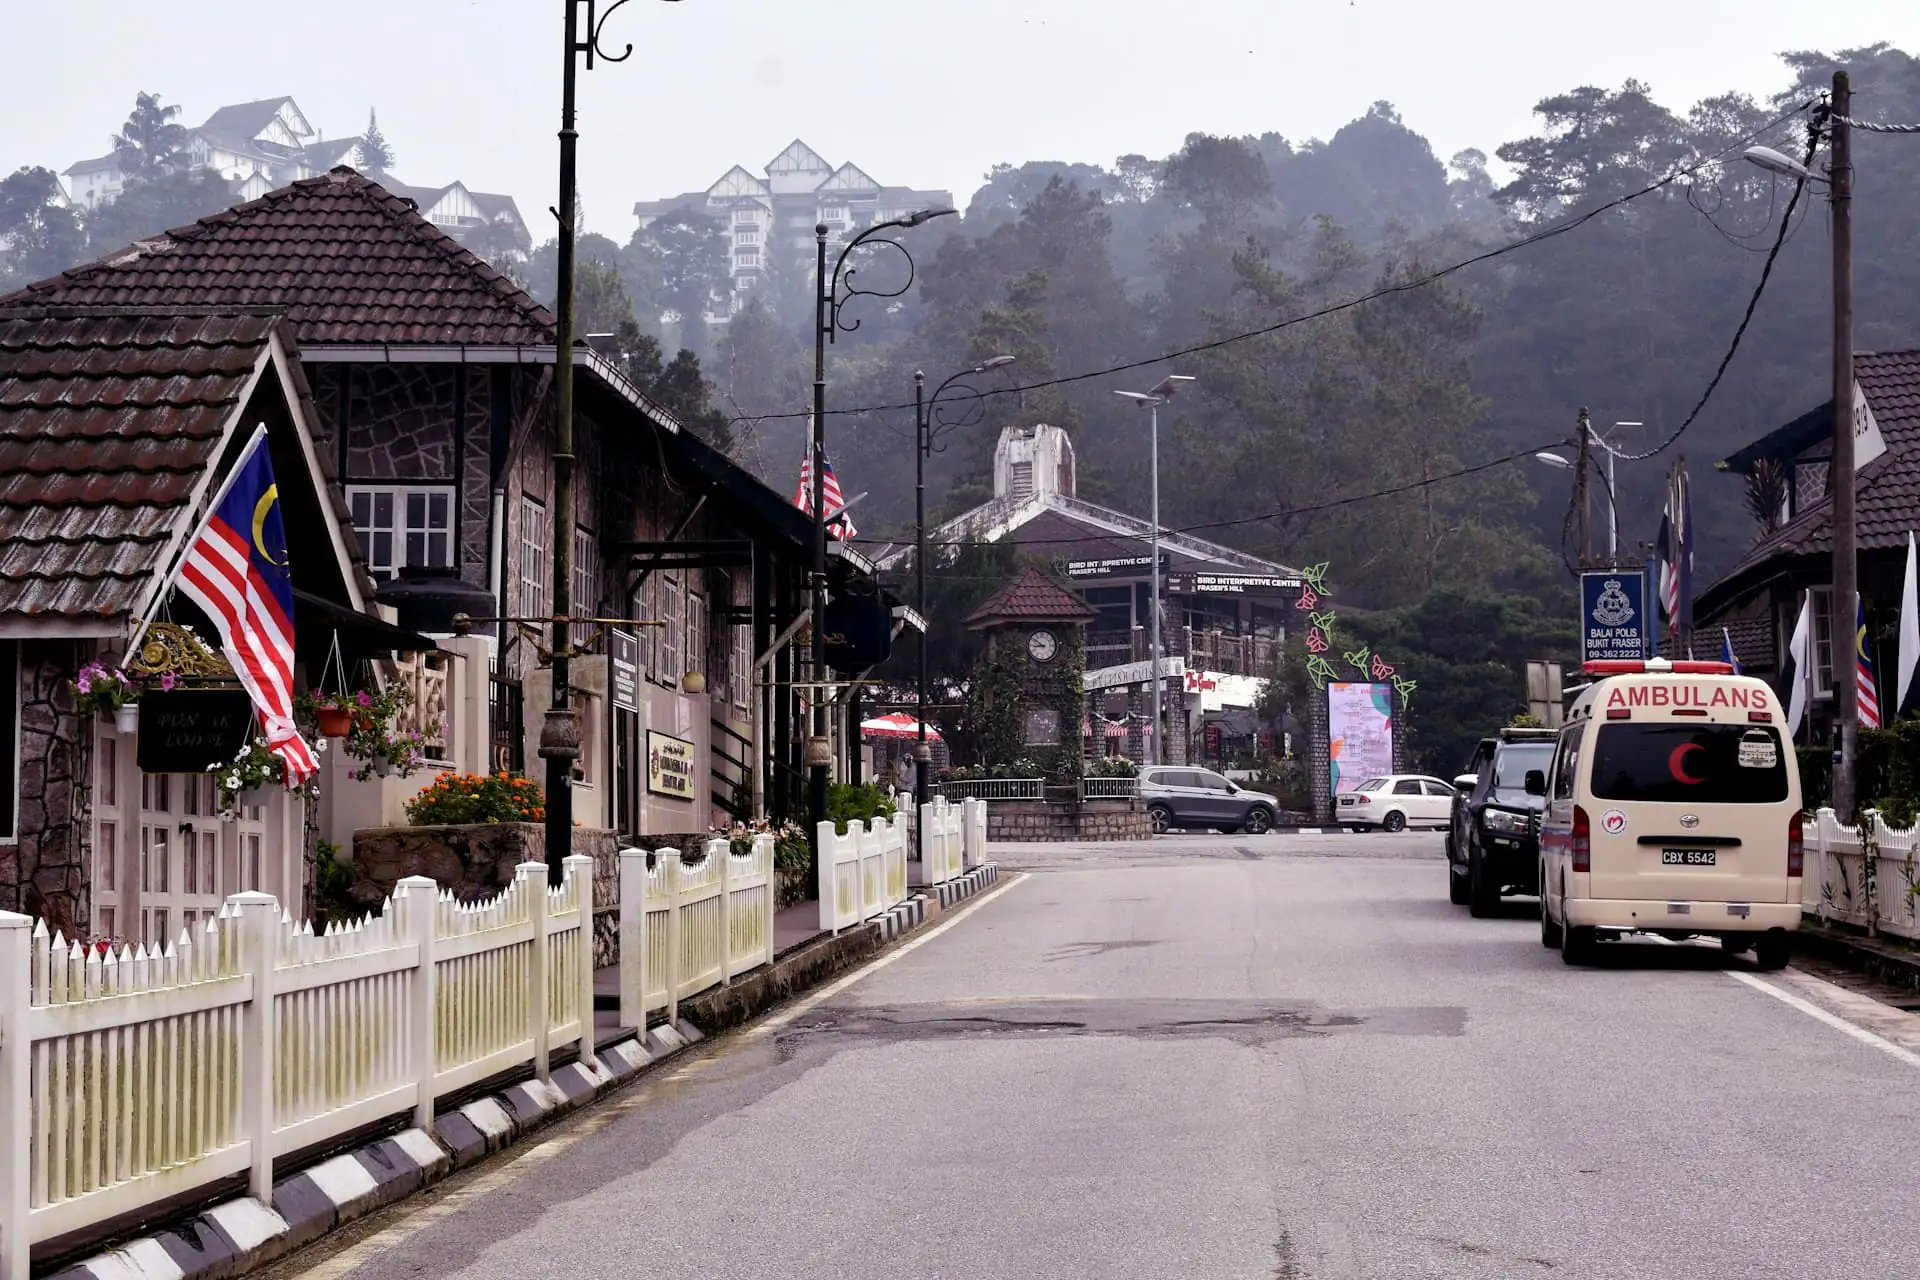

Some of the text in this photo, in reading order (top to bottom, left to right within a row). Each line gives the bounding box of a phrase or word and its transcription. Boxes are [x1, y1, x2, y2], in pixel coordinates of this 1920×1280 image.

[1068, 561, 1086, 569] BIRD
[1087, 558, 1136, 568] INTRPRETIVE
[1197, 576, 1301, 587] BIRD INTERPRETIVE CENTRE
[1590, 628, 1638, 638] BALAI POLIS
[1587, 639, 1642, 649] BUKIT FRASER
[1132, 663, 1169, 682] CUISNE
[1607, 686, 1768, 709] AMBULANS
[1663, 852, 1715, 863] CBX 5542
